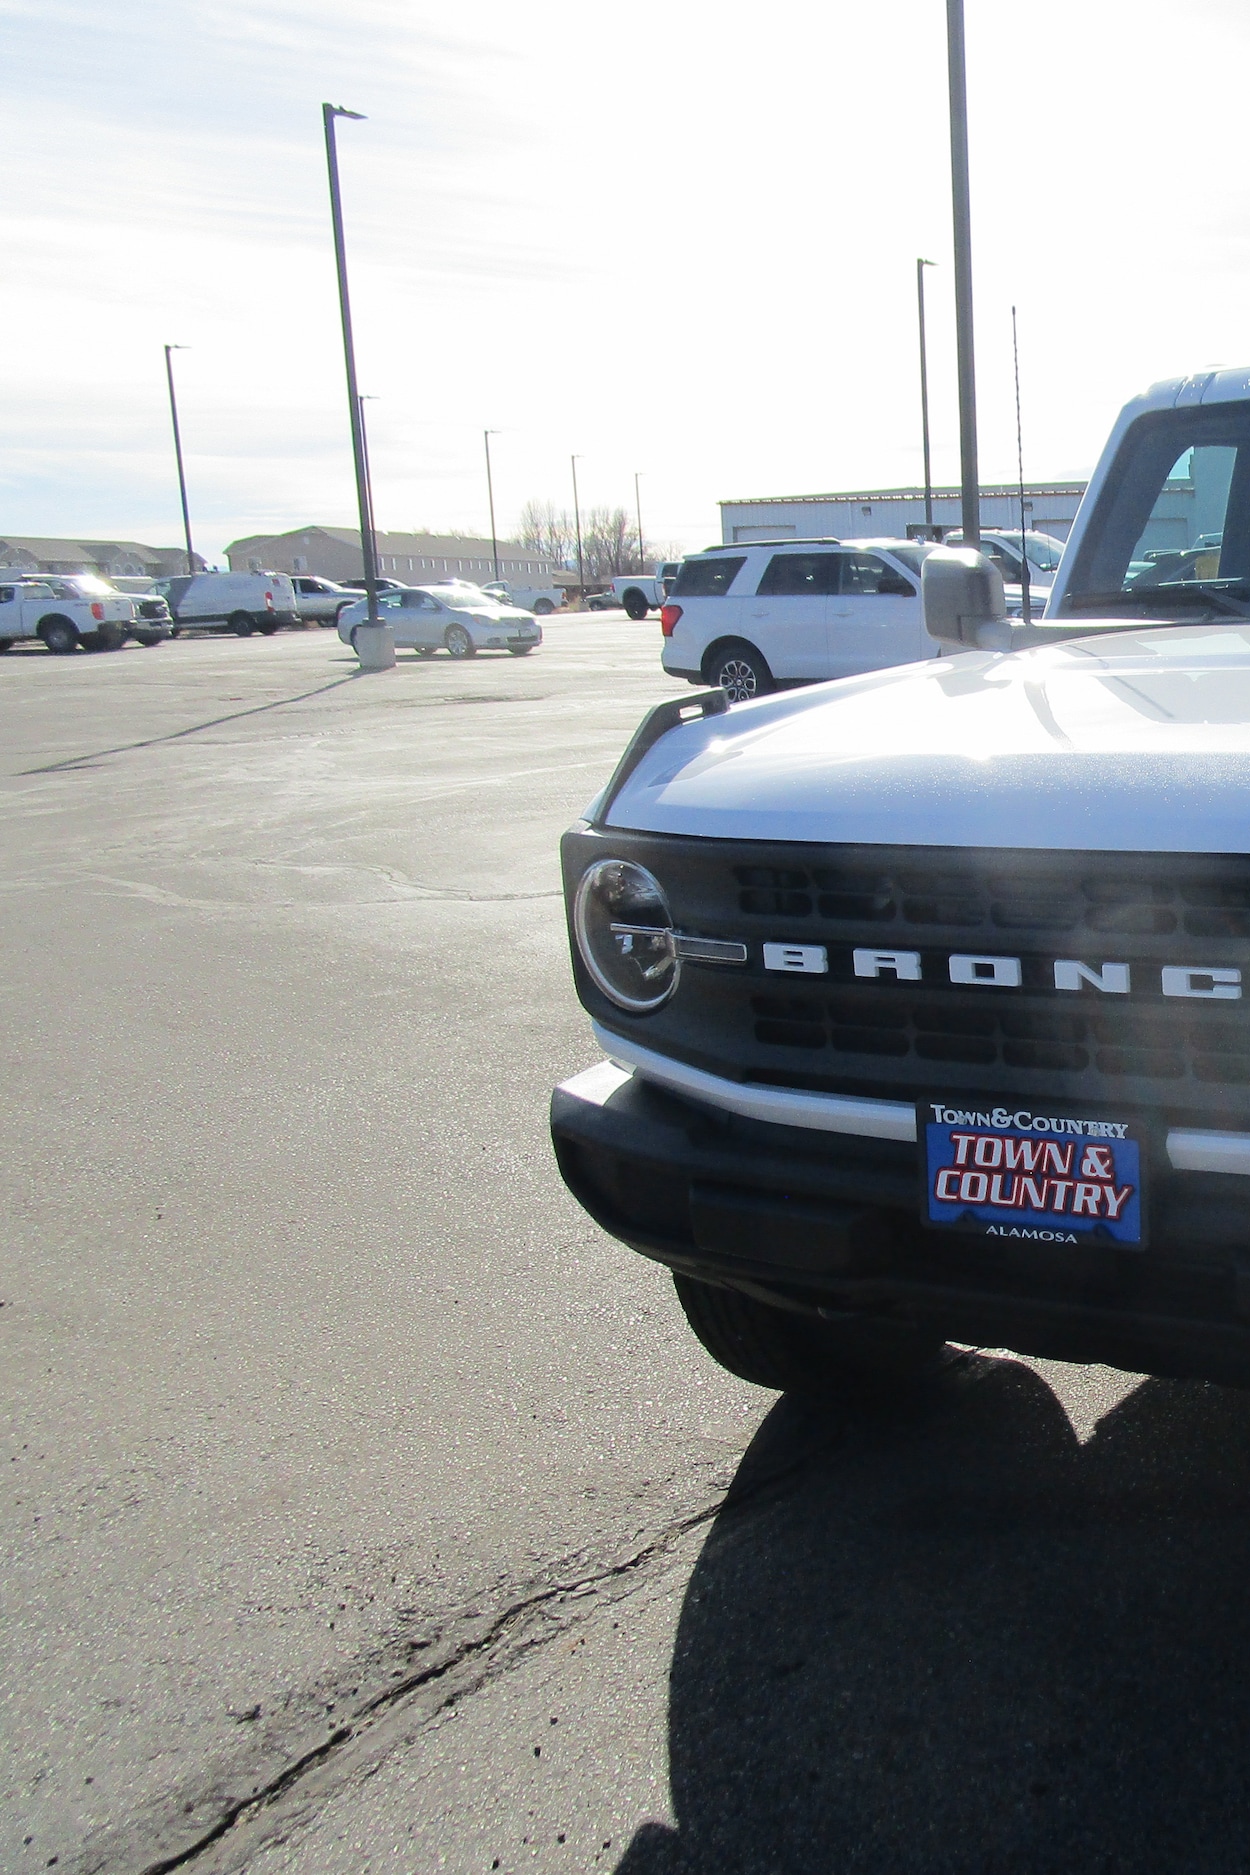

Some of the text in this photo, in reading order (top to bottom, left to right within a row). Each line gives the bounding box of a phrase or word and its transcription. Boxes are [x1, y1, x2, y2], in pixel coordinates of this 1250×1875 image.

[952, 1134, 1112, 1179] TOWN &
[936, 1169, 1130, 1217] COUNTRY
[986, 1225, 1078, 1244] ALAMOSA
